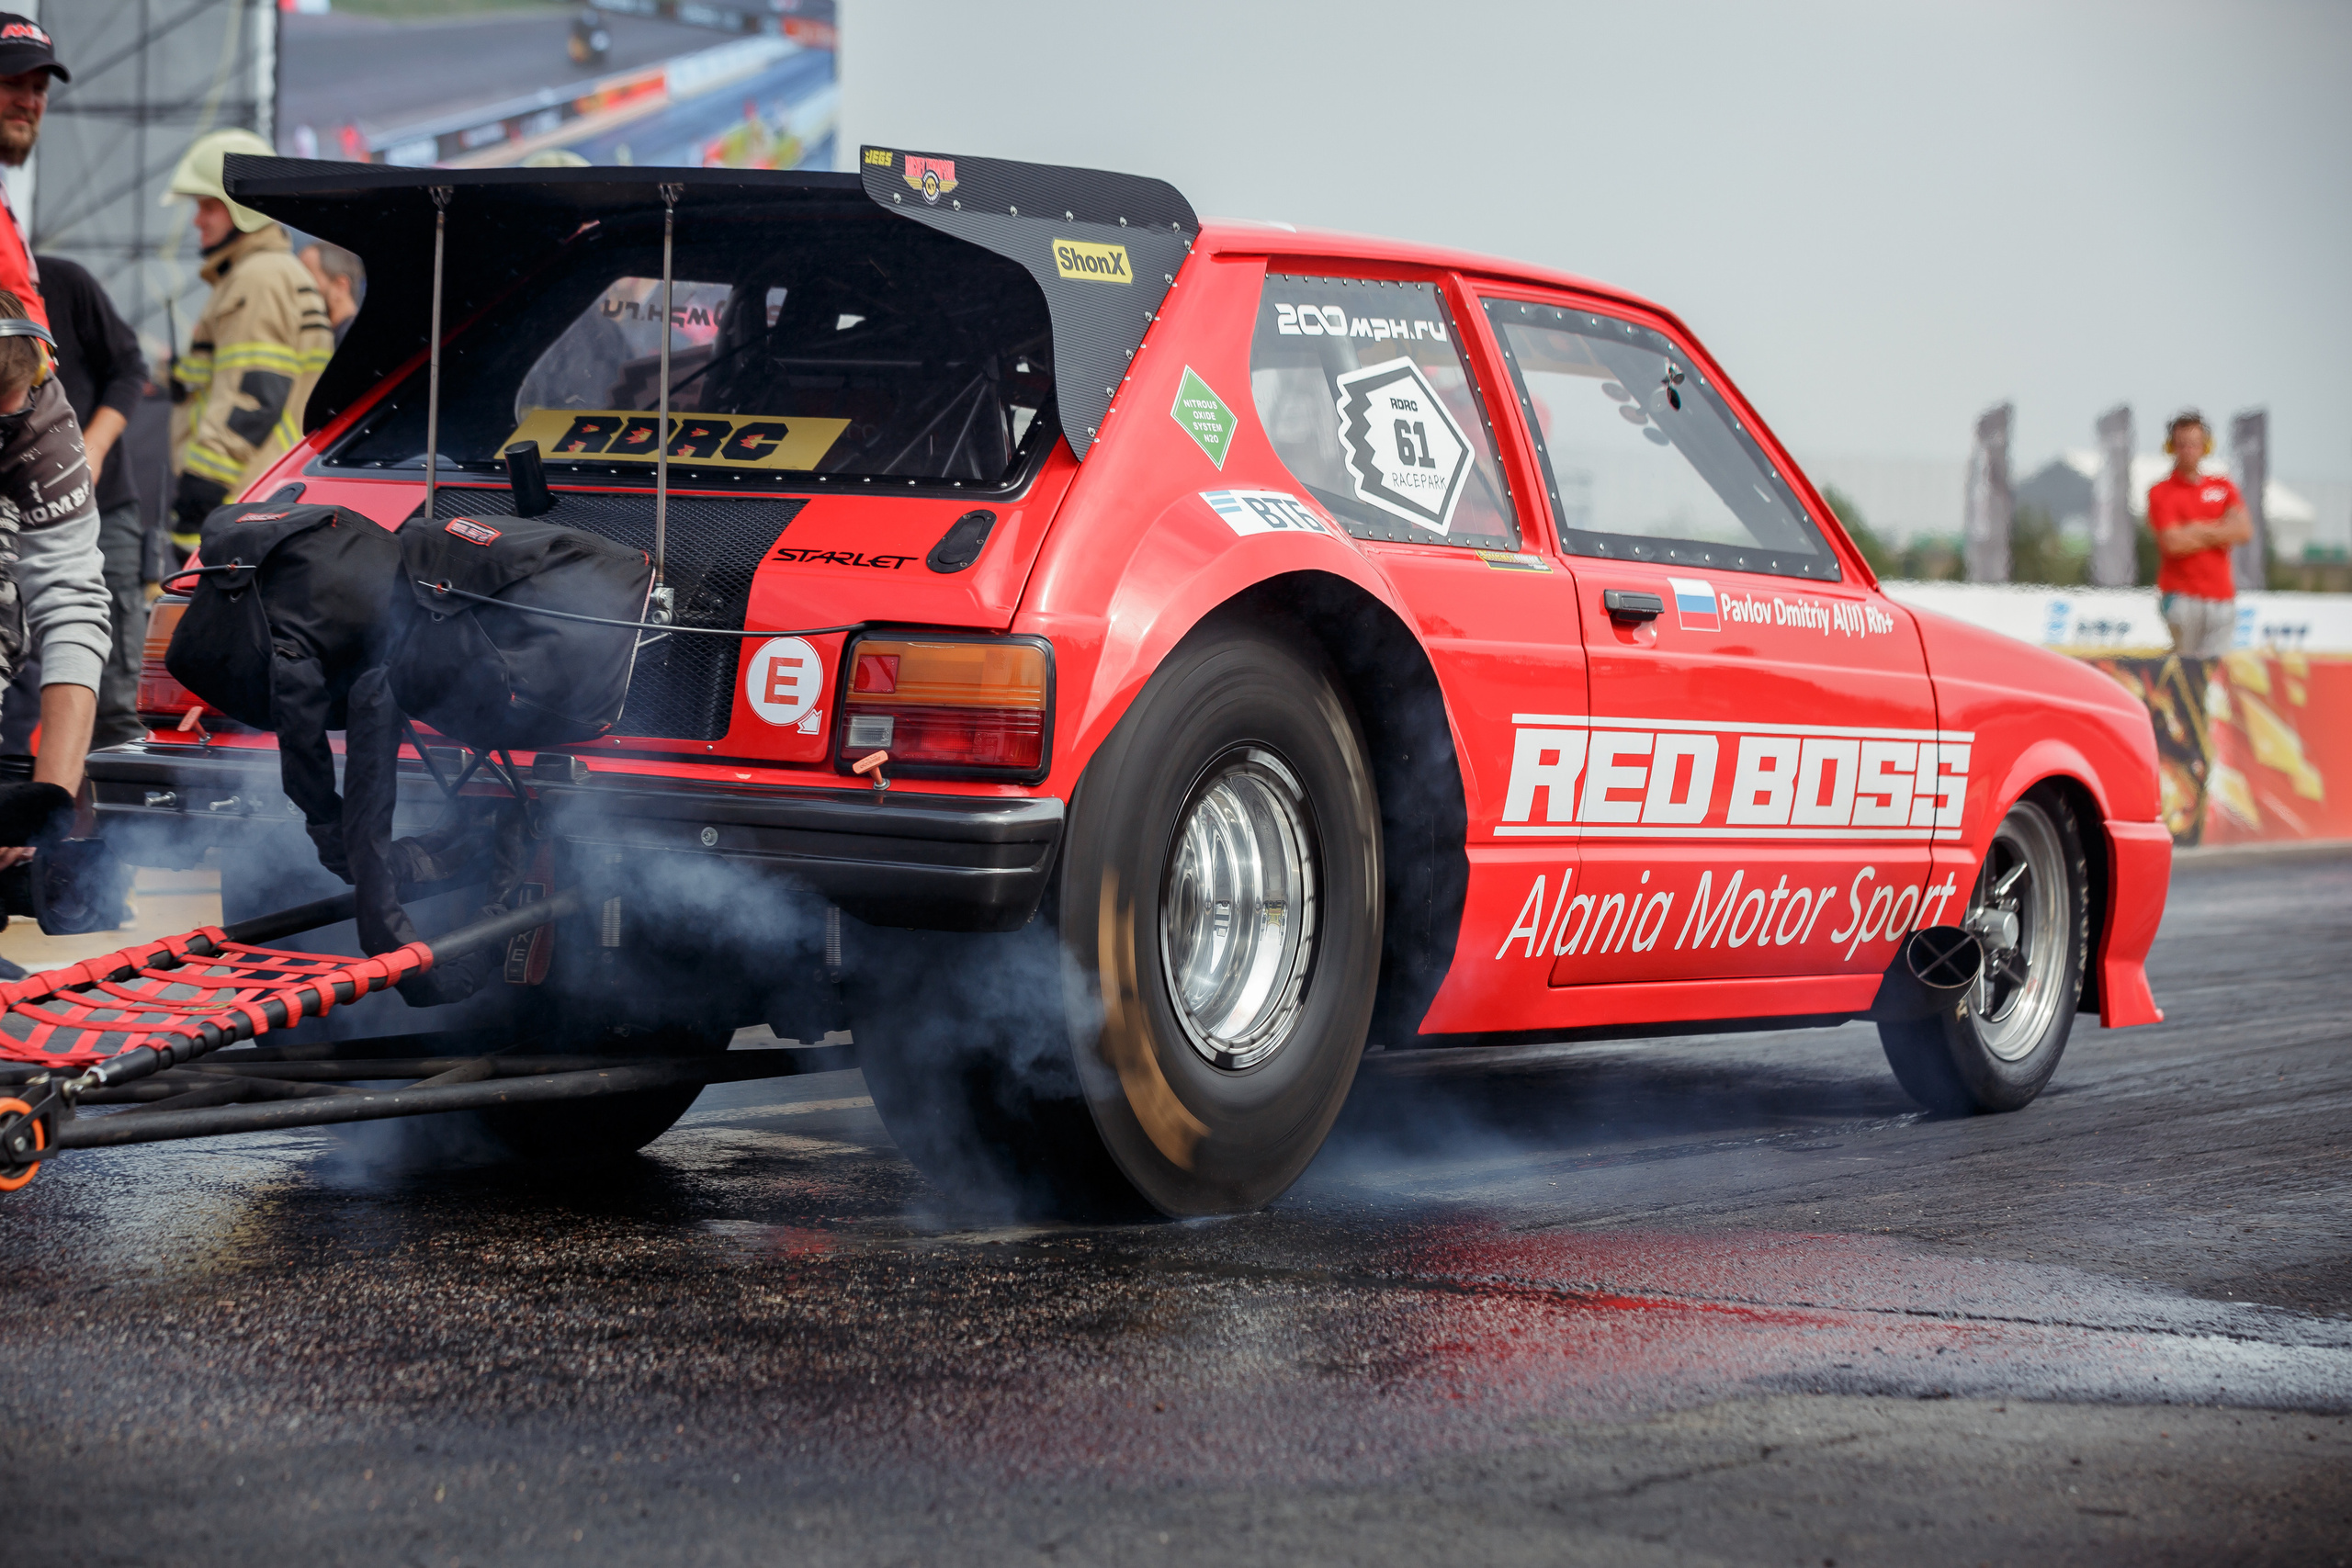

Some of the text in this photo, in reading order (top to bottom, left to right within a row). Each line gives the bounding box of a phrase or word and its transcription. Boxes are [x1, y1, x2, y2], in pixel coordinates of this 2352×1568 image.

[1057, 246, 1125, 276] ShonX
[1183, 399, 1218, 410] NITROUS
[1193, 410, 1216, 421] OXIDE
[1389, 398, 1418, 412] RDRC
[1193, 421, 1223, 433] SYSTEM
[1394, 418, 1435, 468] 61
[1392, 472, 1446, 491] RACEPARK
[772, 548, 920, 570] STARLET
[1721, 592, 1771, 625] Pavlov
[1773, 597, 1829, 637] Dmitriy
[1865, 604, 1894, 635] Rh+
[763, 656, 803, 705] E
[1501, 728, 1972, 827] RED BOSS
[1496, 865, 1957, 962] Alania Motor Sport
